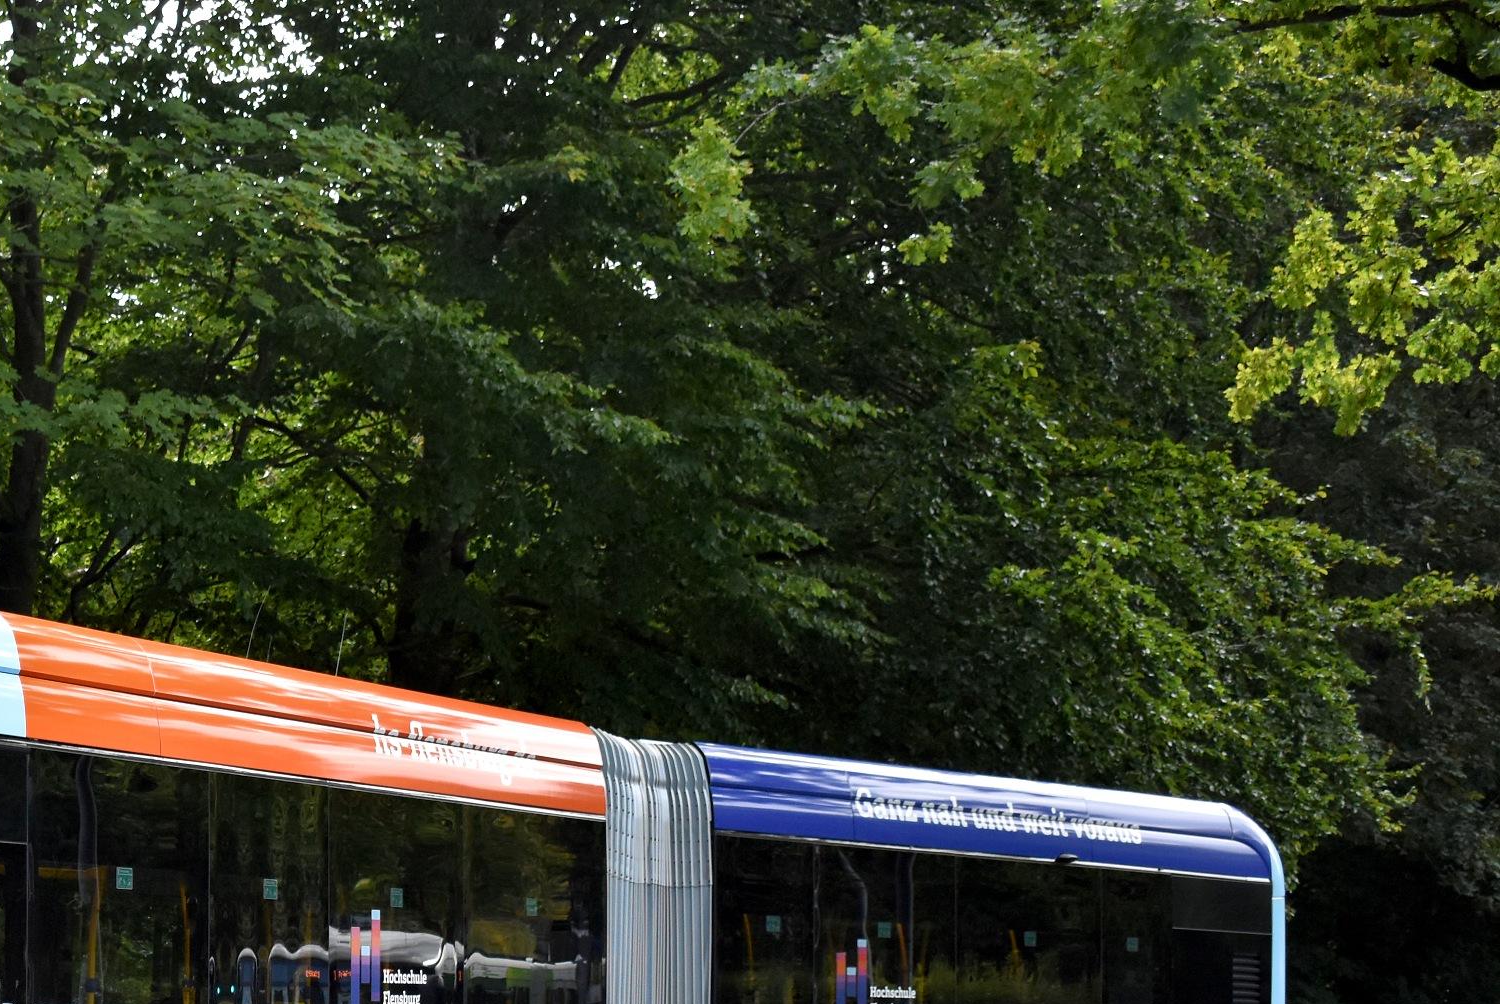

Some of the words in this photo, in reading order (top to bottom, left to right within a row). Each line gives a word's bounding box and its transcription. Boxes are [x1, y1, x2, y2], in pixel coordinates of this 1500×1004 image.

[855, 787, 918, 823] Ganz
[922, 796, 968, 828] nah
[972, 802, 1017, 833] und
[1019, 807, 1069, 838] weit
[1070, 815, 1143, 845] voraus
[382, 969, 427, 985] Hochschule
[869, 986, 916, 999] Hochschule
